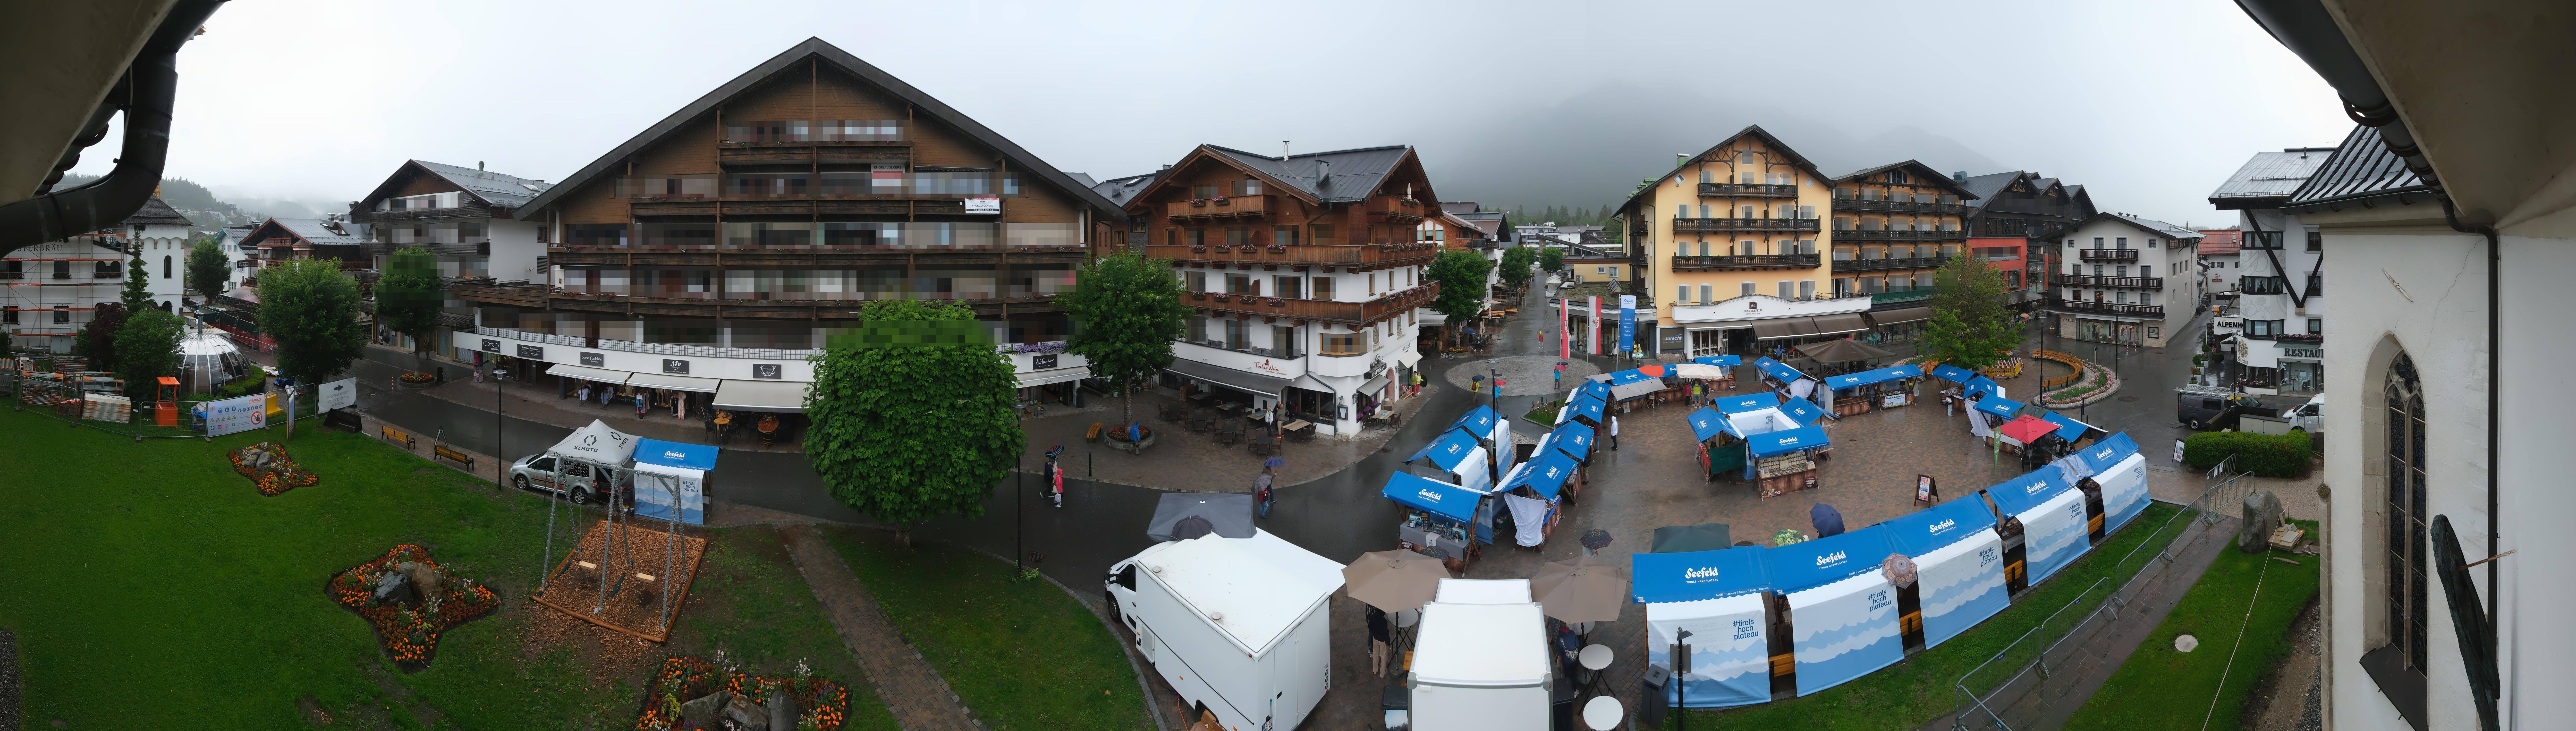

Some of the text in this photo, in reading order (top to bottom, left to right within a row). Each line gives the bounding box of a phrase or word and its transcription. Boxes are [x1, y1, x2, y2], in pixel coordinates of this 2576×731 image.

[1402, 343, 1411, 352] SAILER
[2284, 348, 2324, 358] RESTAU
[2237, 356, 2249, 365] Kaltschmid
[1372, 364, 1386, 377] RESTAURANT
[326, 395, 350, 404] KONGRESSZENTRUM
[1479, 416, 1487, 424] Seefeld
[618, 437, 629, 449] XLMOTO
[1447, 443, 1459, 453] Seefeld
[2097, 448, 2112, 459] Seefeld
[1546, 466, 1557, 478] Seefeld
[2026, 480, 2047, 493] Seefeld
[1419, 488, 1442, 500] Seefeld
[2069, 502, 2080, 511] #tirols
[2072, 506, 2080, 515] hoch
[2070, 509, 2082, 520] plateau
[1930, 518, 1955, 533] Seefeld
[1979, 547, 1994, 557] #tirols
[1983, 551, 1994, 560] hoch
[1816, 550, 1846, 566] Seefeld
[1980, 555, 1997, 567] plateau
[1685, 566, 1718, 579] Seefeld
[1868, 590, 1887, 600] #tirols
[1873, 595, 1886, 604] hoch
[1870, 600, 1891, 613] plateau
[1733, 618, 1754, 628] #tirols
[1734, 631, 1759, 641] plateau
